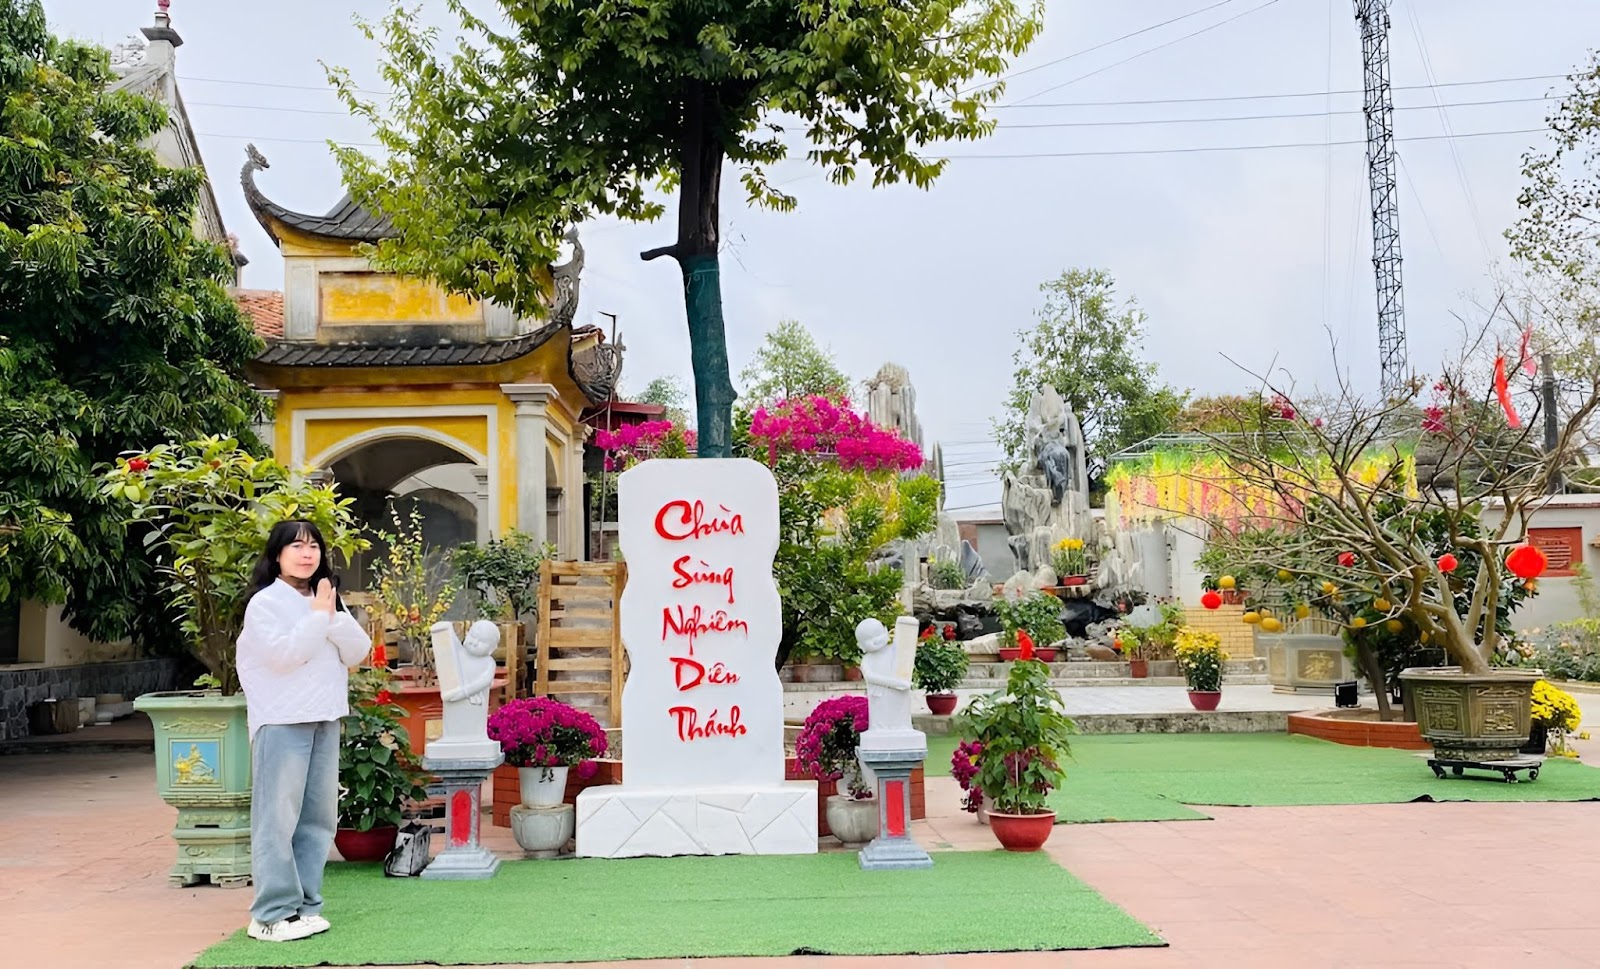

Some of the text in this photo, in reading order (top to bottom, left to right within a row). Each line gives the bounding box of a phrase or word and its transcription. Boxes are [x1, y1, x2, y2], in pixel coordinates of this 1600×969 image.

[653, 499, 745, 541] Chùa
[671, 554, 735, 604] Sùng
[661, 604, 749, 656] Nghiêm
[669, 656, 741, 692] Diên
[668, 705, 748, 741] Thánh
